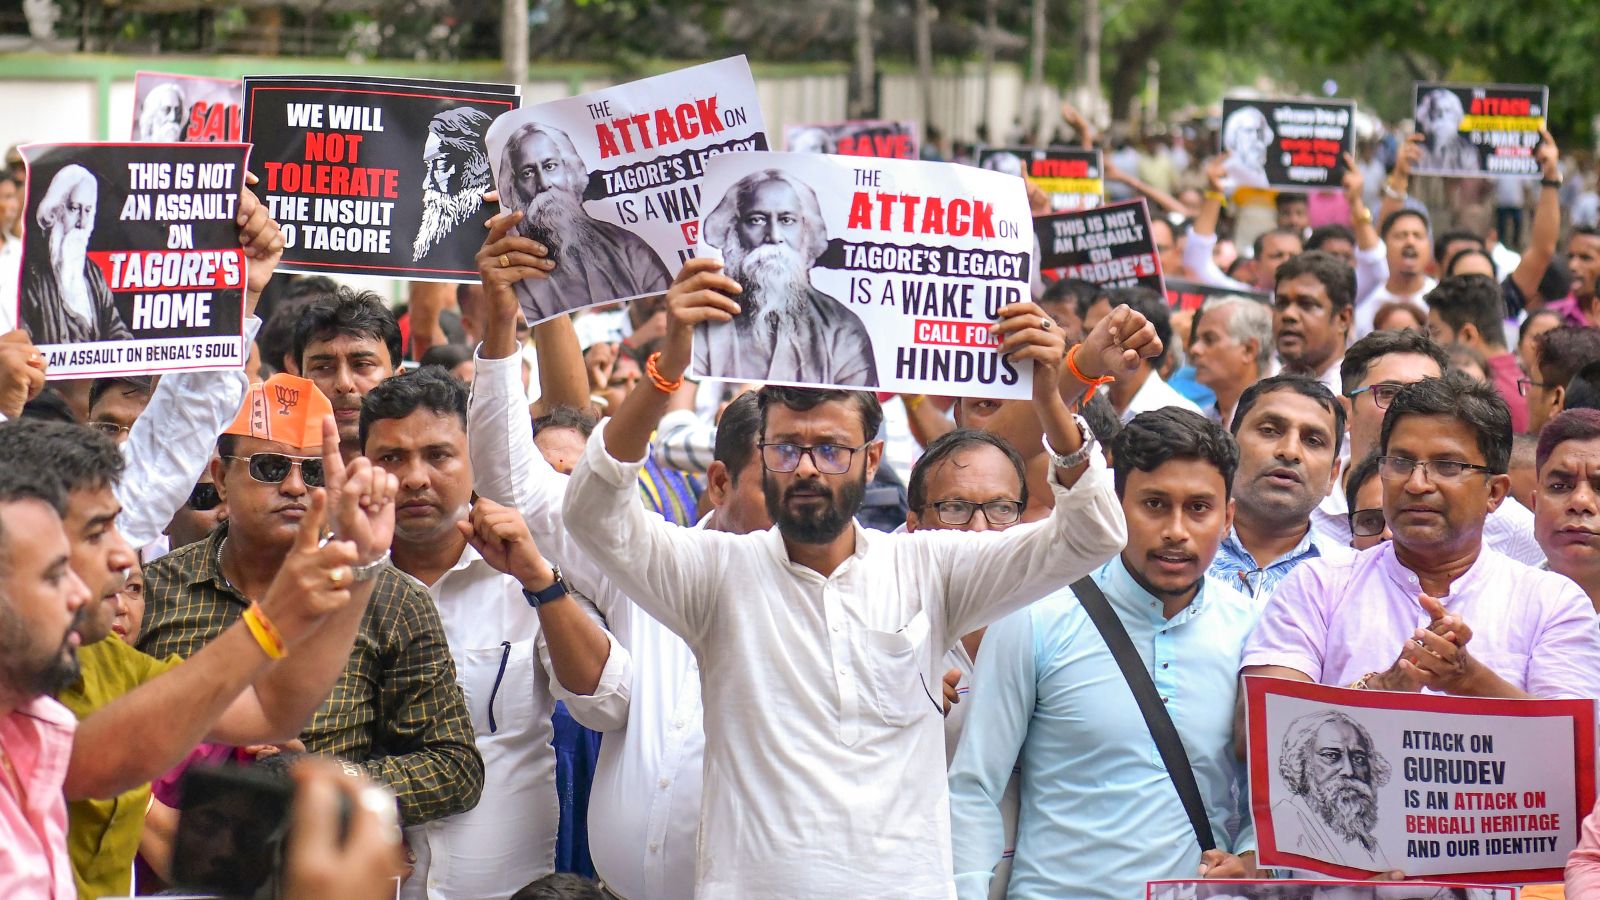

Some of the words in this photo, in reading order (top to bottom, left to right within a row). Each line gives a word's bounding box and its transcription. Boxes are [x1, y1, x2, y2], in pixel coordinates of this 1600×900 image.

[287, 103, 324, 128] WE
[328, 104, 384, 132] WILL
[587, 100, 613, 120] THE
[595, 95, 724, 160] ATTACK
[724, 107, 747, 128] ON
[305, 132, 363, 163] NOT
[128, 163, 170, 190] THIS
[174, 163, 194, 189] IS
[198, 163, 235, 190] NOT
[265, 162, 399, 198] TOLERATE
[602, 156, 686, 194] TAGORE'S
[854, 168, 881, 187] THE
[120, 194, 150, 221] AN
[155, 193, 237, 221] ASSAULT
[266, 195, 309, 222] THE
[314, 198, 394, 226] INSULT
[616, 199, 639, 225] IS
[645, 196, 659, 221] A
[656, 184, 701, 223] WA
[847, 191, 996, 240] ATTACK
[999, 219, 1019, 239] ON
[168, 224, 193, 249] ON
[1054, 218, 1086, 237] THIS
[1087, 215, 1104, 233] IS
[1105, 210, 1136, 231] NOT
[278, 224, 296, 248] O
[301, 225, 391, 254] TAGORE
[1054, 237, 1074, 254] AN
[1075, 224, 1144, 251] ASSAULT
[843, 244, 941, 273] TAGORE'S
[947, 251, 1022, 279] LEGACY
[1089, 247, 1112, 263] ON
[109, 252, 240, 288] TAGORE'S
[132, 293, 212, 330] HOME
[850, 277, 872, 304] IS
[881, 280, 896, 306] A
[902, 280, 974, 319] WAKE
[918, 323, 960, 343] CALL
[49, 351, 66, 367] AN
[69, 348, 123, 366] ASSAULT
[126, 347, 143, 363] ON
[146, 343, 203, 362] BENGAL'S
[205, 342, 238, 359] SOUL
[896, 347, 1019, 386] HINDUS
[1402, 730, 1464, 753] ATTACK
[1470, 733, 1493, 754] ON
[1403, 757, 1506, 785] GURUDEV
[1404, 789, 1420, 809] IS
[1426, 790, 1449, 810] AN
[1454, 791, 1517, 810] ATTACK
[1523, 791, 1546, 809] ON
[1405, 814, 1476, 835] BENGALI
[1481, 812, 1560, 834] HERITAGE
[1407, 838, 1440, 859] AND
[1446, 839, 1480, 857] OUR
[1485, 835, 1558, 856] IDENTITY
